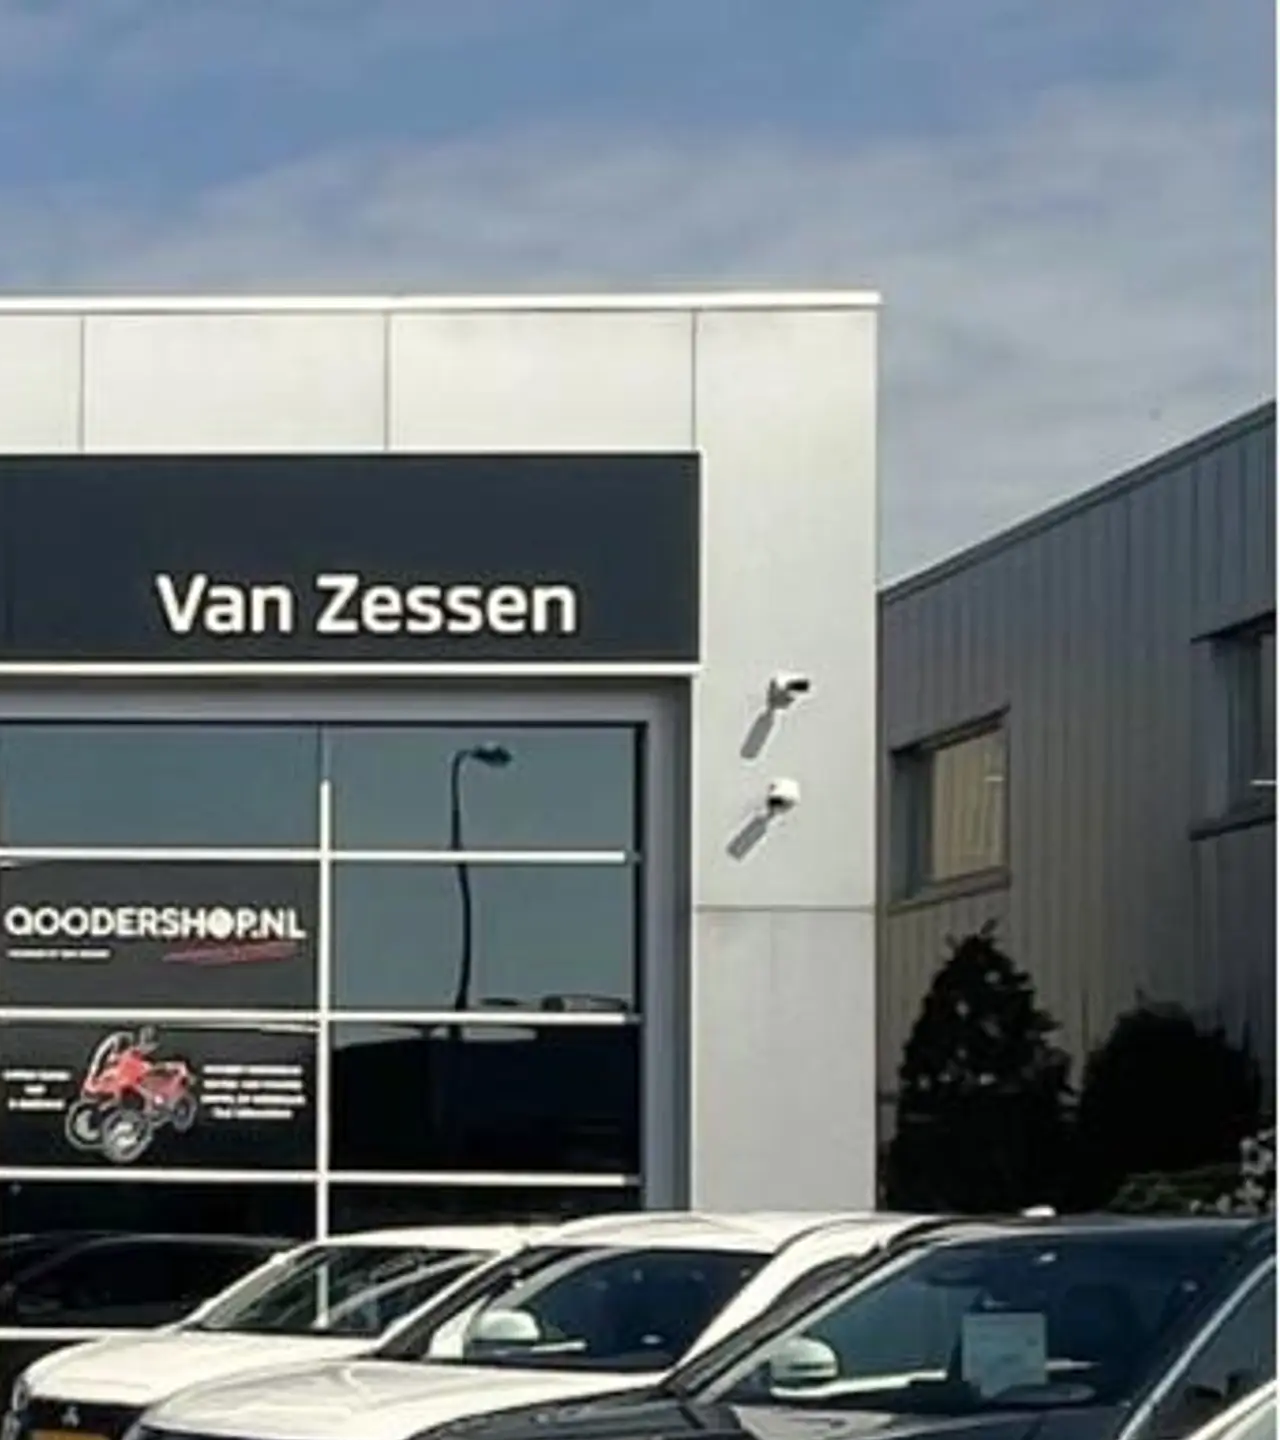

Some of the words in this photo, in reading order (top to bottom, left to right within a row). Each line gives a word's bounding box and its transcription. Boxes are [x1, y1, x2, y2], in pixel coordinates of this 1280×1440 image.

[155, 573, 294, 634] Van
[315, 573, 578, 634] Zessen
[3, 906, 307, 939] QOODERSHOP.NL
